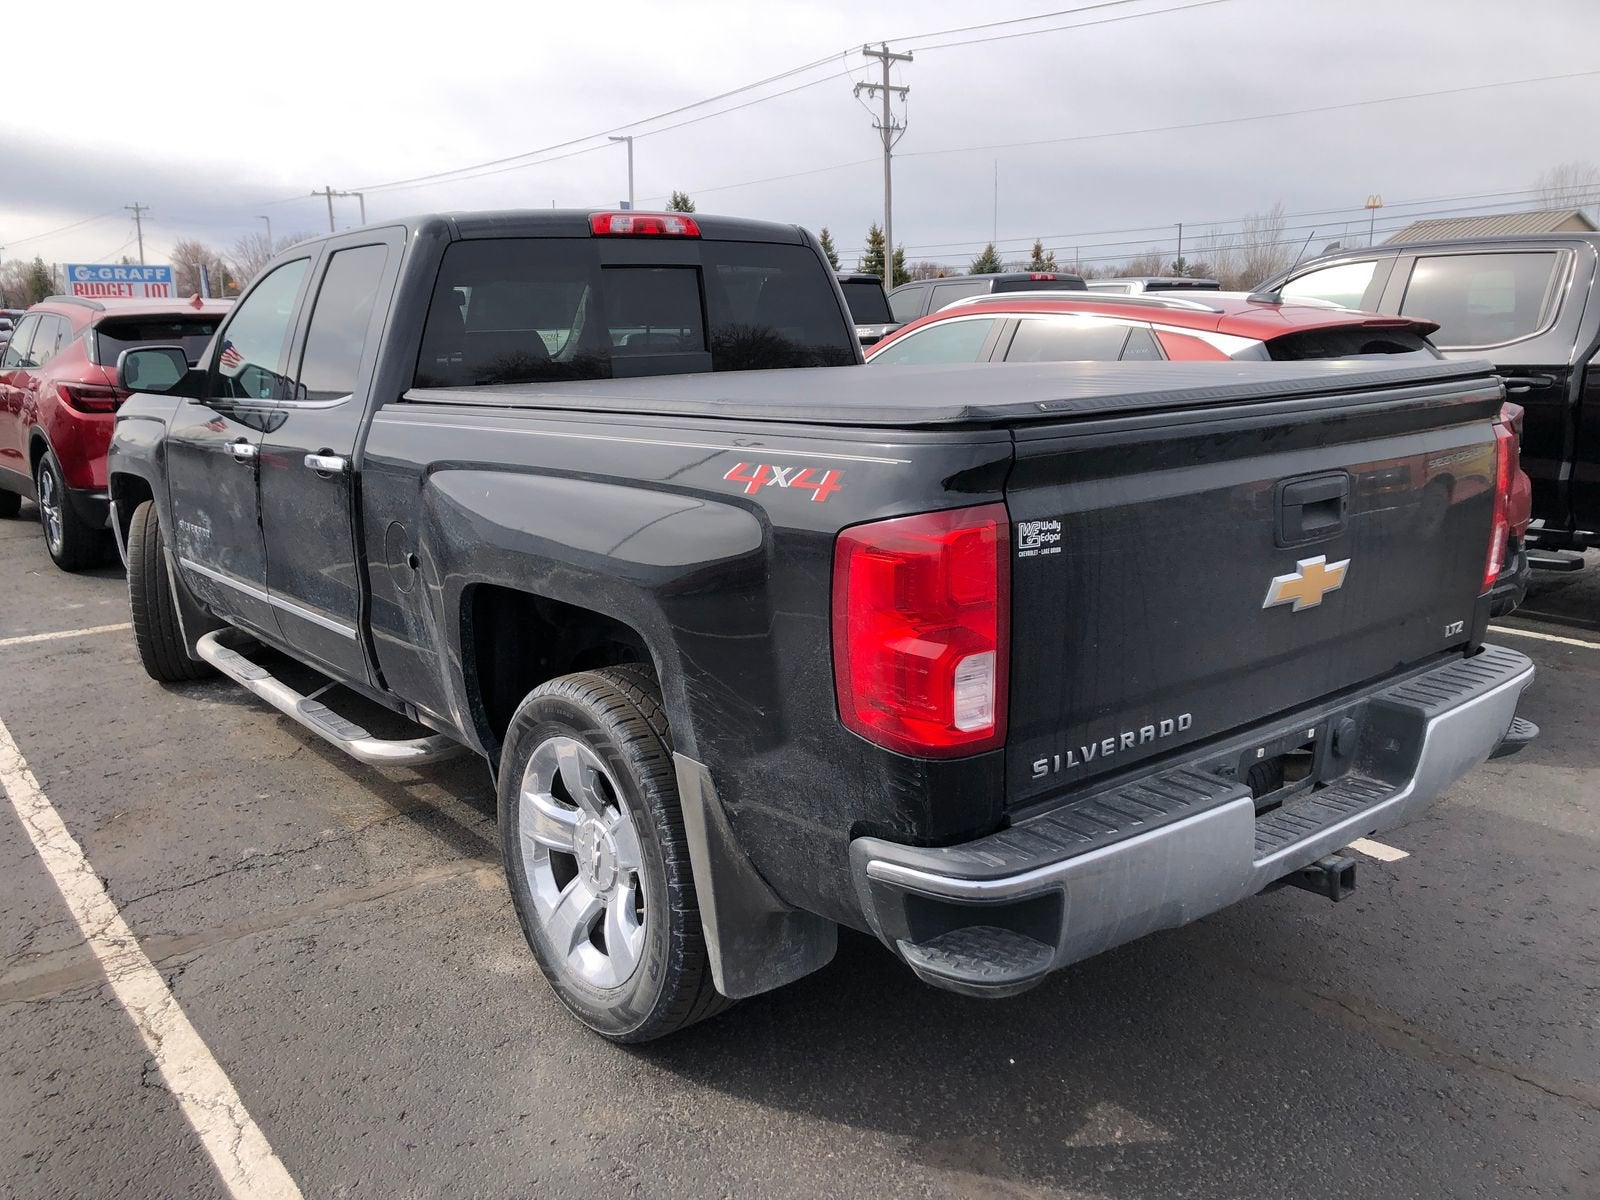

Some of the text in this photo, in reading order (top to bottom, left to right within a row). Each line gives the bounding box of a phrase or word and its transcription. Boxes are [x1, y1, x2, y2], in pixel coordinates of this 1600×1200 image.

[98, 268, 166, 280] GRAFF
[1040, 520, 1061, 532] Wally
[1040, 532, 1061, 543] Edgar
[1444, 620, 1463, 638] LTZ
[1032, 713, 1192, 779] SILVERADO
